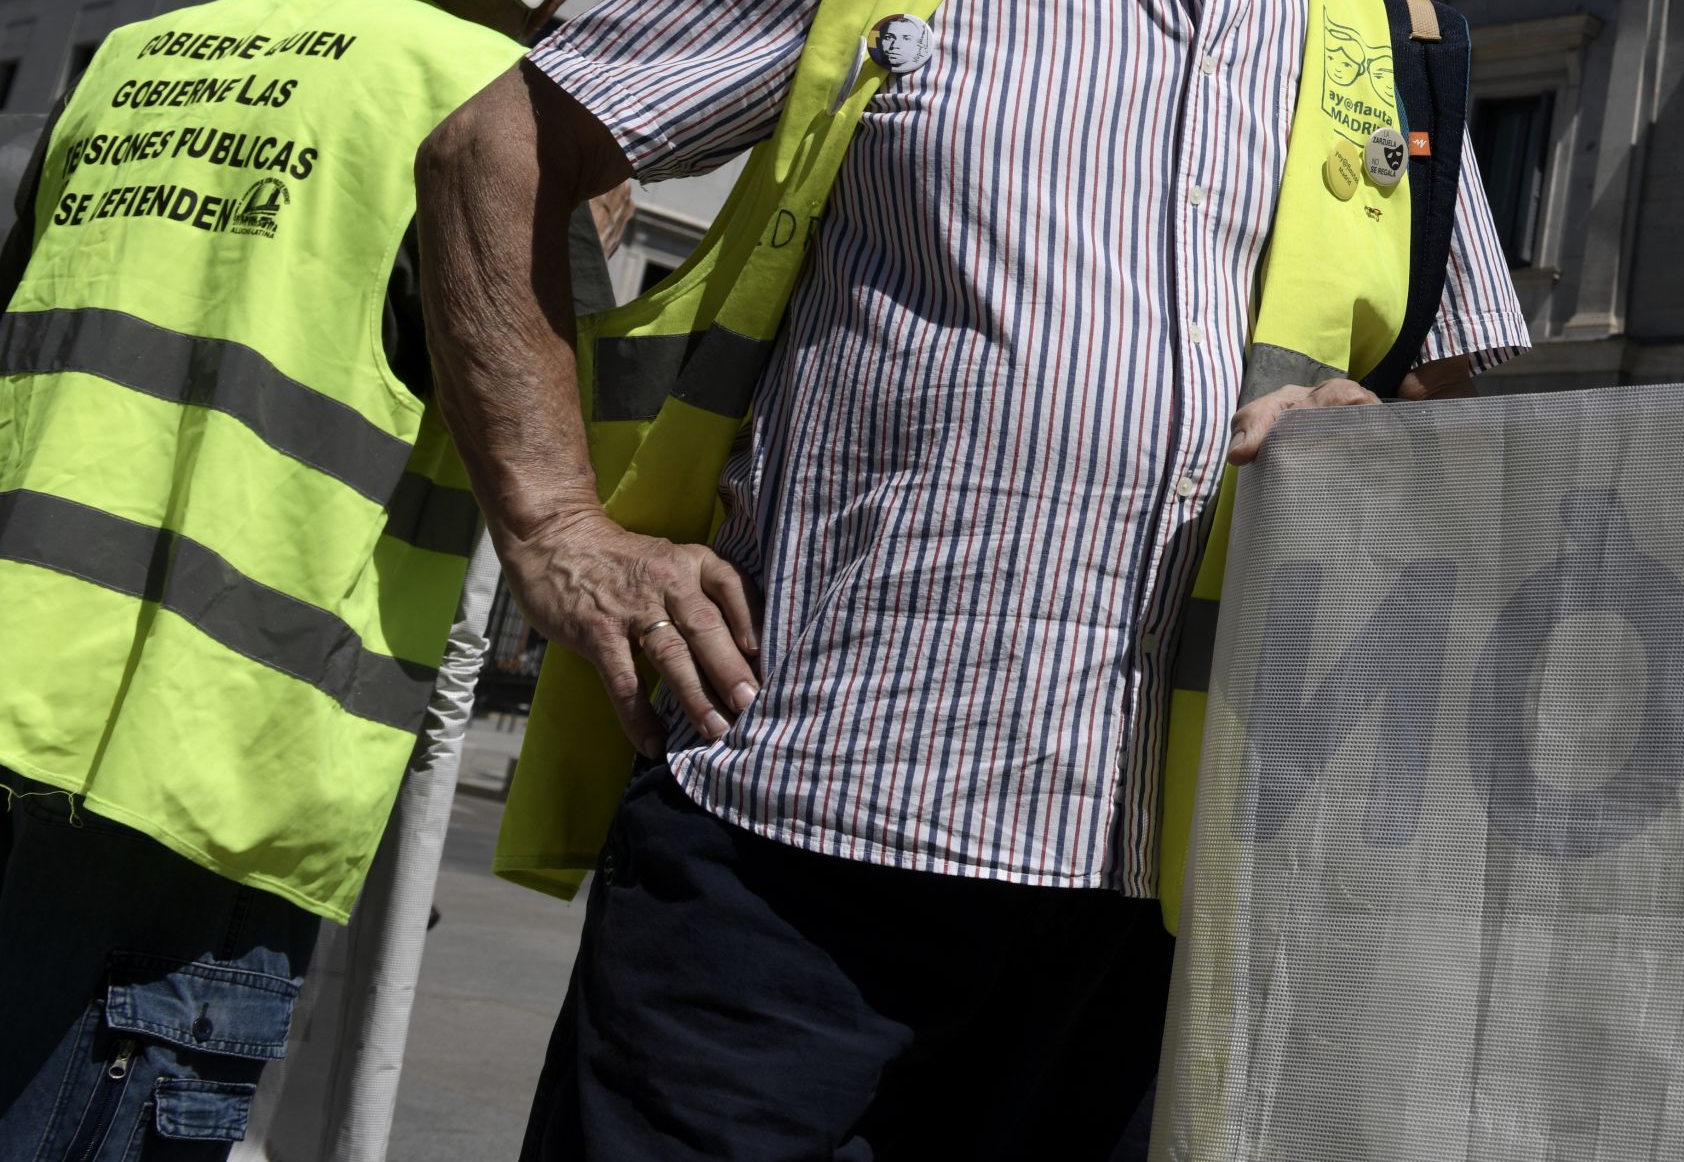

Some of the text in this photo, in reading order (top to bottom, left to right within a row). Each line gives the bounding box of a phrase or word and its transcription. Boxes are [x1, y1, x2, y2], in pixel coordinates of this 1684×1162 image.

[111, 74, 298, 109] GOBIERNE LAS
[1331, 106, 1381, 135] MADRI
[172, 127, 319, 180] PUBLICAS
[1372, 136, 1397, 148] ZARZUELA
[1370, 166, 1397, 178] SE REGALA
[54, 193, 94, 226] SE
